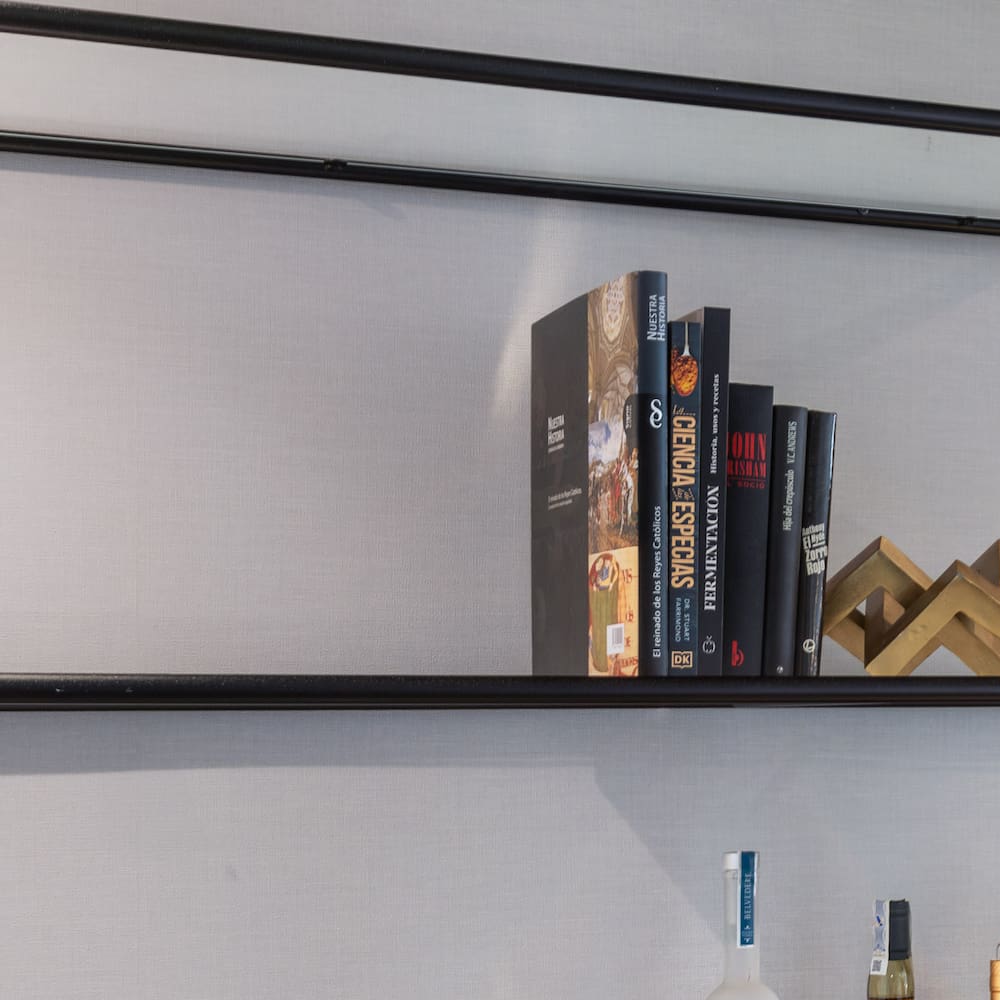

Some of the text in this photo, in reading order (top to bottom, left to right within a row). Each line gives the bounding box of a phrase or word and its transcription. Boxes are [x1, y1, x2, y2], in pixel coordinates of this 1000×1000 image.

[647, 294, 657, 341] NUESTRA
[657, 295, 666, 341] HISTORIA
[672, 415, 696, 487] CIENCIA
[710, 436, 718, 474] Historia,
[671, 501, 696, 589] ESPECIAS
[807, 559, 826, 575] Rojo
[652, 505, 662, 658] El reinado de los Reyes Católicos
[683, 613, 691, 641] STUART
[674, 654, 690, 665] DK
